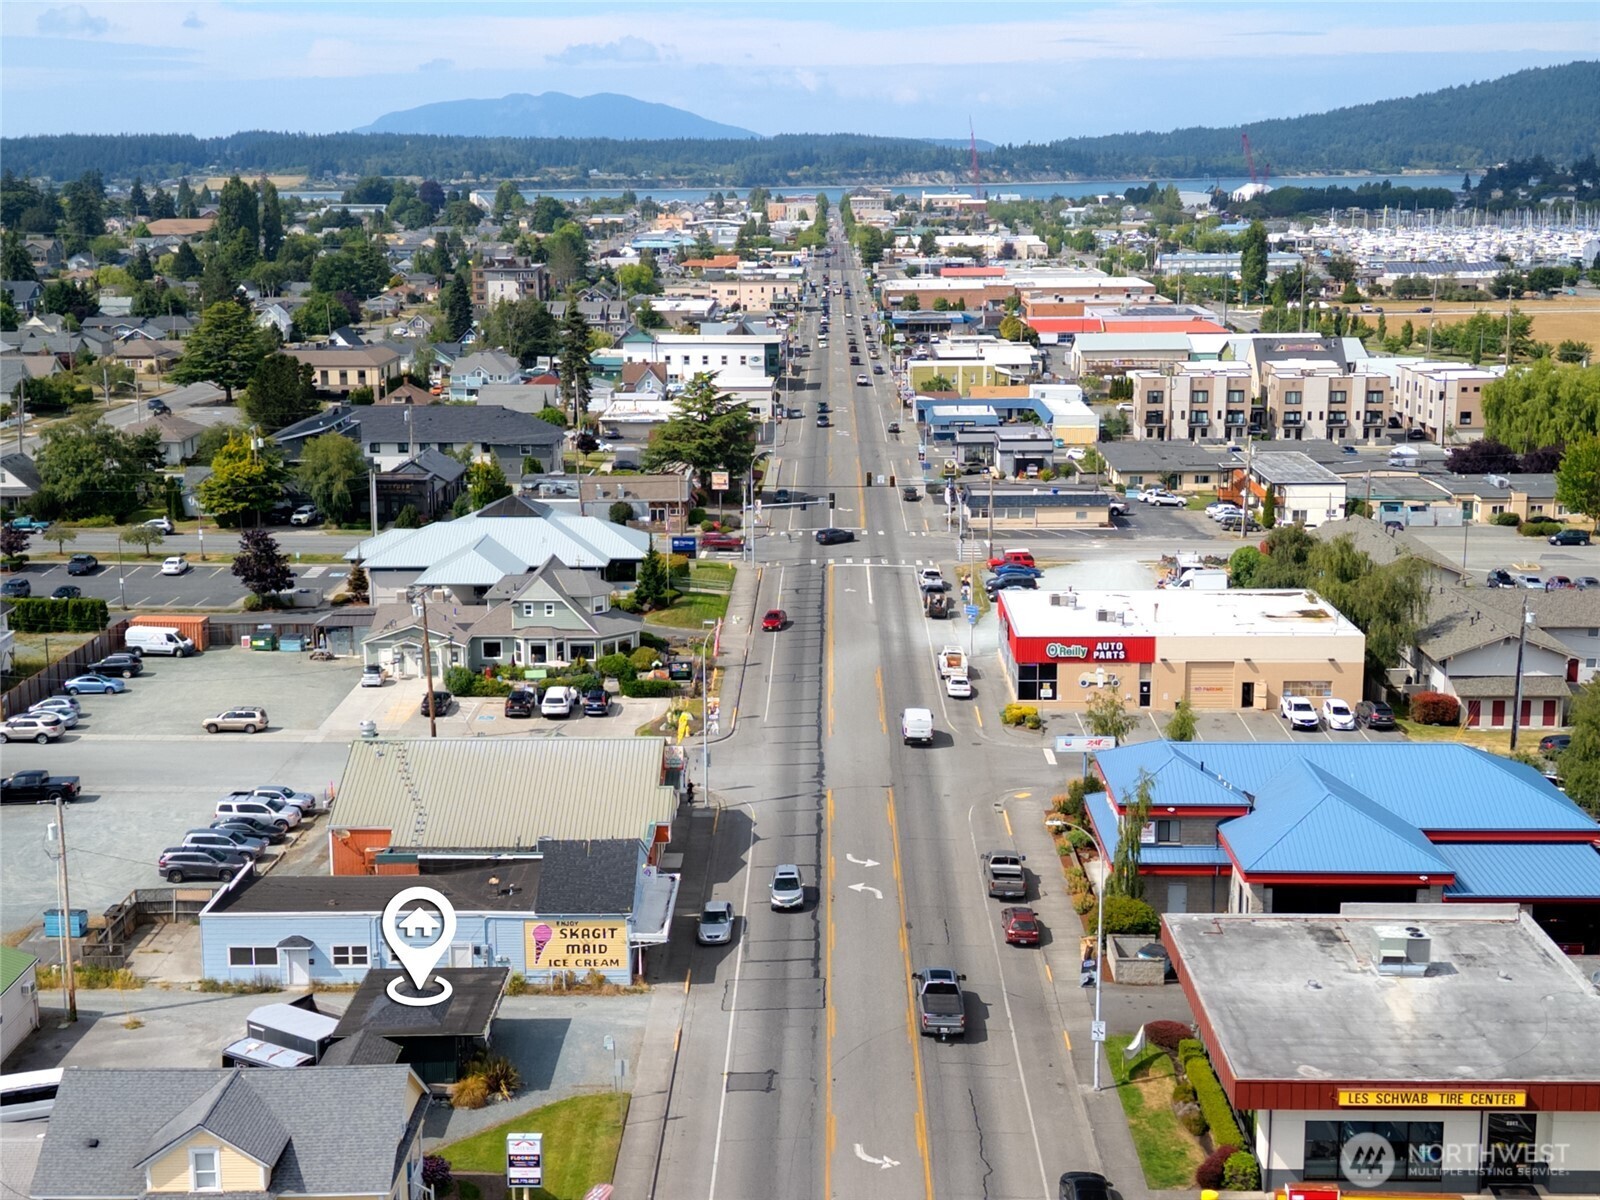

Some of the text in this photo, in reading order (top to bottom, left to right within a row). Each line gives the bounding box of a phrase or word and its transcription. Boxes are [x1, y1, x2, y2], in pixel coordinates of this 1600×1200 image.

[1046, 643, 1087, 658] O'Reilly
[1096, 642, 1123, 651] AUTO
[1093, 651, 1125, 660] PARTS
[560, 928, 618, 938] SKAGIT
[566, 944, 608, 954] MAID
[548, 959, 620, 967] ICE CREAM
[1348, 1093, 1516, 1105] LES SCHWAB TIRE CENTER
